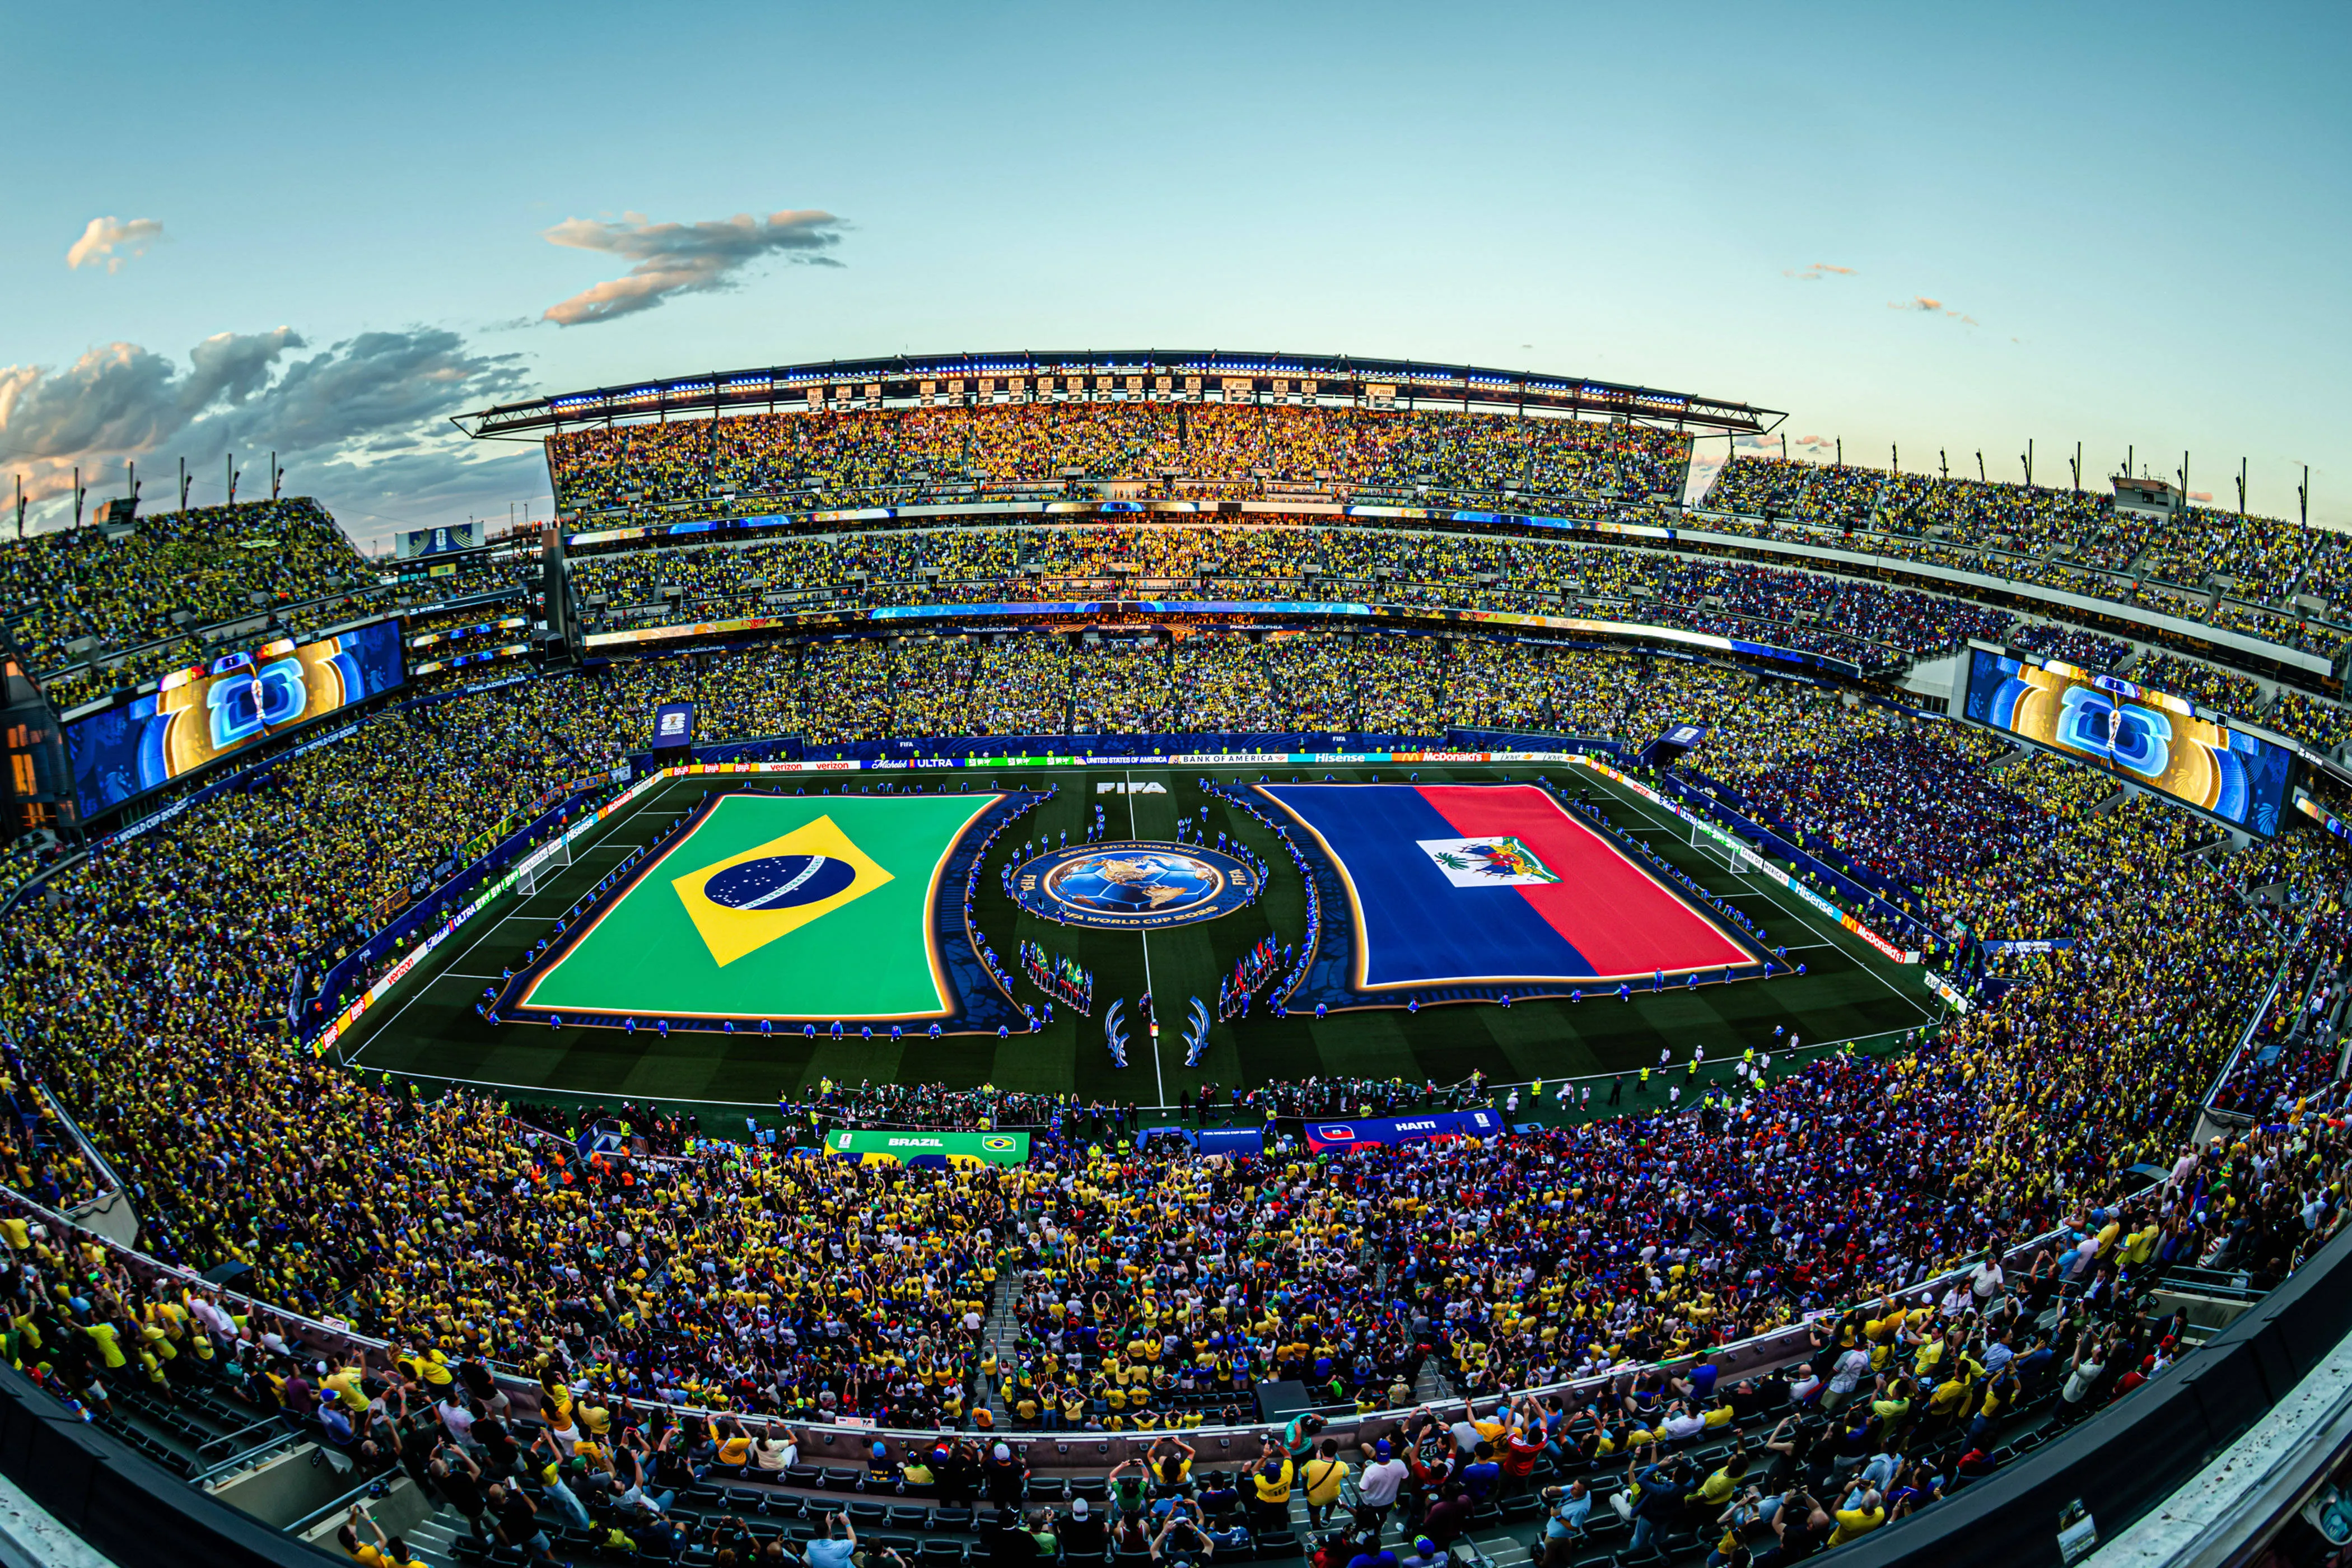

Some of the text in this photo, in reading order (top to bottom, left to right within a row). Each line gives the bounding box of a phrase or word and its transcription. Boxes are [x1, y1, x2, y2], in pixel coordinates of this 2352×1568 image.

[1517, 637, 1570, 646] PHILADELPHIA
[674, 645, 726, 654] PHILADELPHIA
[467, 676, 526, 693] PHILADELPHIA
[295, 725, 358, 757] FIFA WORLD CUP 2026
[1315, 753, 1366, 762] Hisense
[1422, 752, 1483, 762] McDonald's
[1500, 753, 1521, 762] Dove
[1542, 753, 1564, 762] Dove
[704, 764, 720, 773] Lay's
[735, 763, 750, 772] Lay's
[770, 763, 802, 771] verizon
[816, 762, 849, 770] verizon
[871, 759, 953, 769] Michelob ULTRA
[674, 766, 689, 776] Lay's
[1096, 782, 1167, 794] FIFA
[1632, 783, 1650, 798] verizon
[1679, 786, 1688, 794] FIFA
[609, 793, 632, 813] McDonald's
[1680, 809, 1697, 827] ULTRA
[119, 823, 146, 842] WORLD
[146, 815, 161, 829] CUP
[567, 818, 594, 841] Hisense
[1058, 848, 1099, 858] 2026
[1228, 869, 1247, 885] FIFA
[1764, 863, 1782, 880] MERICA
[1020, 875, 1037, 891] FIFA
[1795, 882, 1834, 917] Hisense
[453, 906, 476, 927] ULTRA
[1088, 916, 1141, 925] WORLD
[1174, 905, 1219, 921] 2026
[1857, 925, 1903, 963] McDonald's
[387, 958, 414, 986] verizon
[351, 999, 365, 1020] Lay's
[324, 1025, 338, 1049] Lay's
[1395, 1121, 1437, 1131] HAITI
[888, 1138, 943, 1146] BRAZIL
[1650, 1394, 1661, 1406] 10
